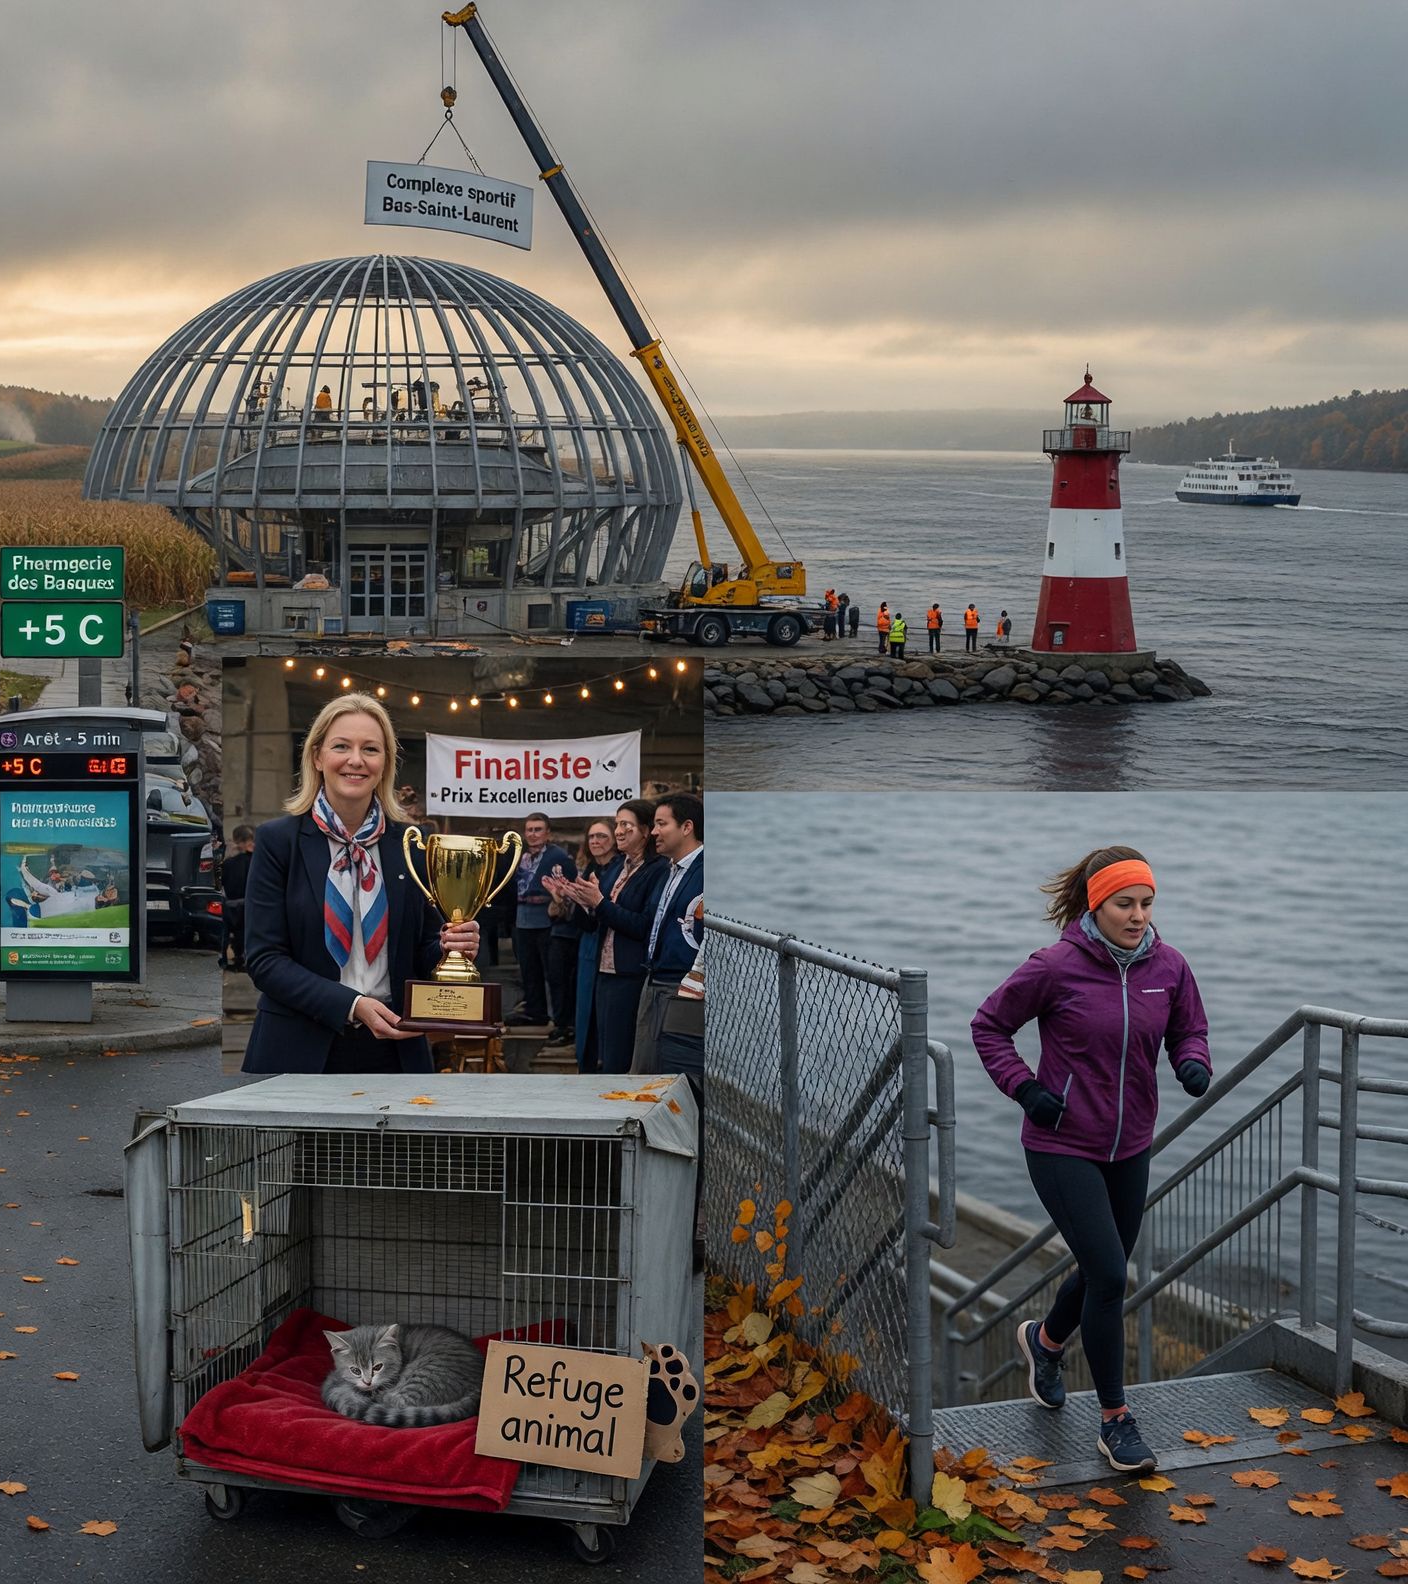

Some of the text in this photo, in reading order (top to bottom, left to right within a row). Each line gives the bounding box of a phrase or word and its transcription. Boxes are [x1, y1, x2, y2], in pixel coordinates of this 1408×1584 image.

[387, 173, 516, 208] Complexe sportif
[383, 197, 519, 233] Bas-Saint-Laurent
[8, 575, 38, 590] des
[19, 615, 104, 645] +5 C
[77, 732, 87, 745] 5
[93, 732, 121, 745] min
[1, 758, 42, 775] +5 C
[455, 750, 592, 780] Finaliste
[441, 787, 473, 803] Prix
[503, 1354, 624, 1420] Refuge
[501, 1414, 616, 1457] animal
